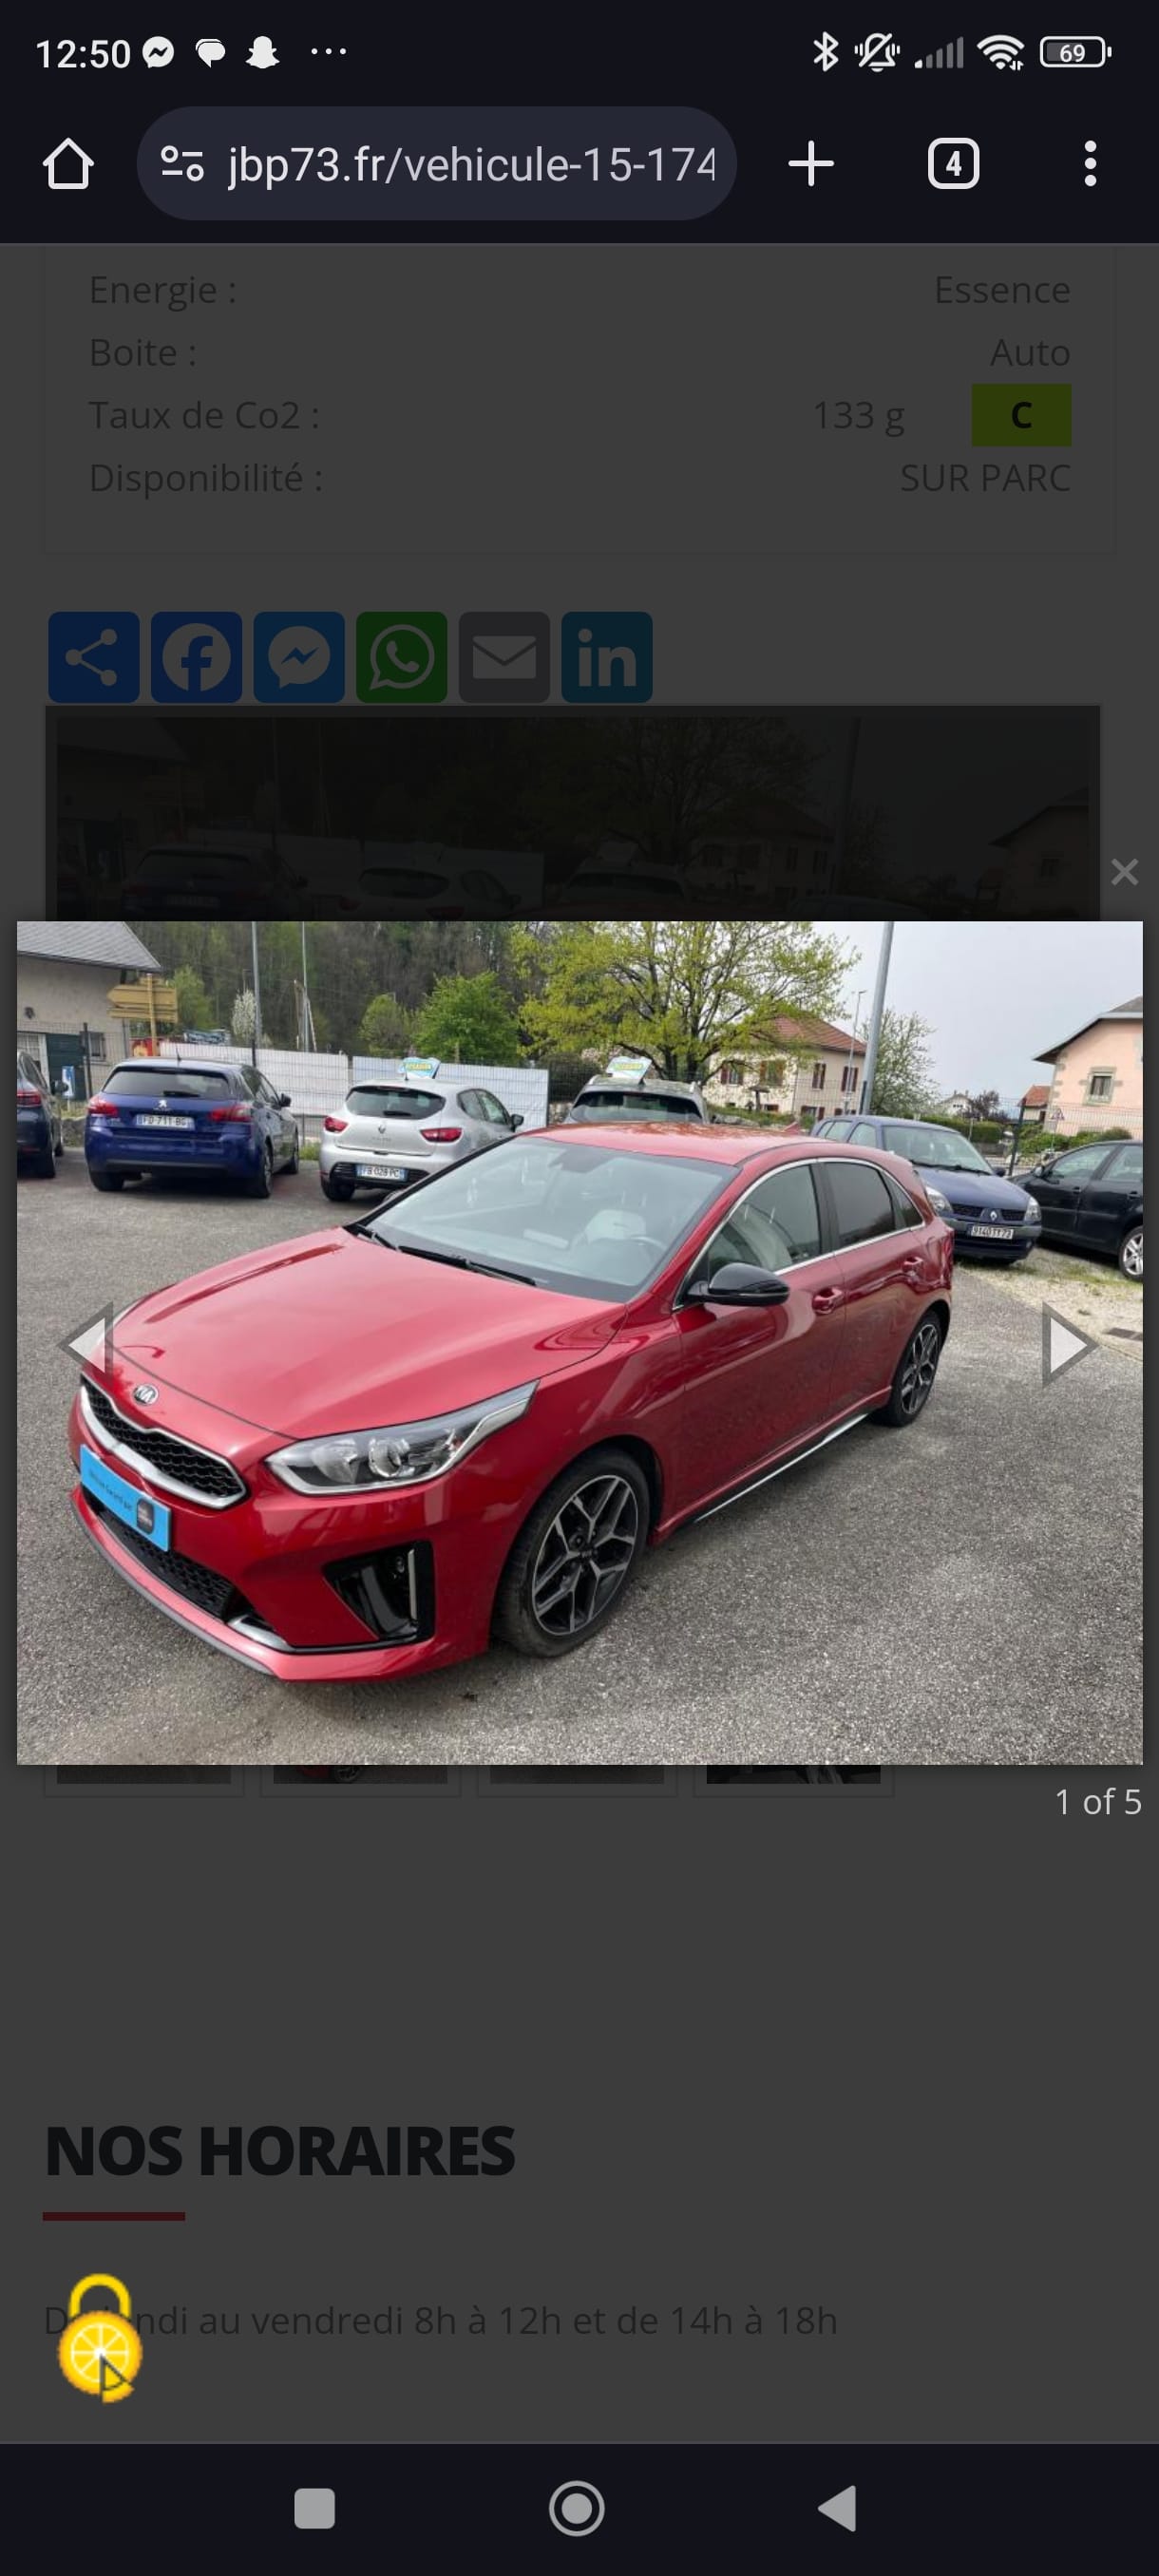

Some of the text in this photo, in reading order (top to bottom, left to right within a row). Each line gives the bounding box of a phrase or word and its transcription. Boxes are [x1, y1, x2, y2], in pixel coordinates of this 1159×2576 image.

[37, 39, 130, 68] 12:50
[1060, 44, 1085, 62] 69
[228, 145, 714, 191] jbp73.fr/vehicule-15-174
[945, 150, 961, 176] 4
[91, 275, 217, 312] Energie
[937, 275, 1071, 304] Essence
[91, 337, 177, 368] Boite
[990, 339, 1070, 367] Auto
[88, 401, 171, 429] Taux
[182, 400, 224, 430] de
[236, 401, 299, 430] Co2
[815, 401, 904, 437] 133 g
[1012, 402, 1032, 428] C
[91, 462, 303, 501] Disponibilité
[902, 464, 1071, 494] SUR PARC
[579, 629, 636, 686] in
[1056, 1788, 1142, 1815] 1 of 5
[48, 2126, 515, 2176] NOS HORAIRES
[200, 2313, 239, 2335] au
[251, 2305, 402, 2335] vendredi
[415, 2306, 455, 2335] 8h
[468, 2305, 485, 2335] à
[502, 2306, 560, 2335] 12h
[574, 2309, 606, 2335] et
[618, 2306, 657, 2335] de
[673, 2306, 732, 2335] 14h
[745, 2305, 761, 2335] à
[777, 2306, 836, 2335] 18h
